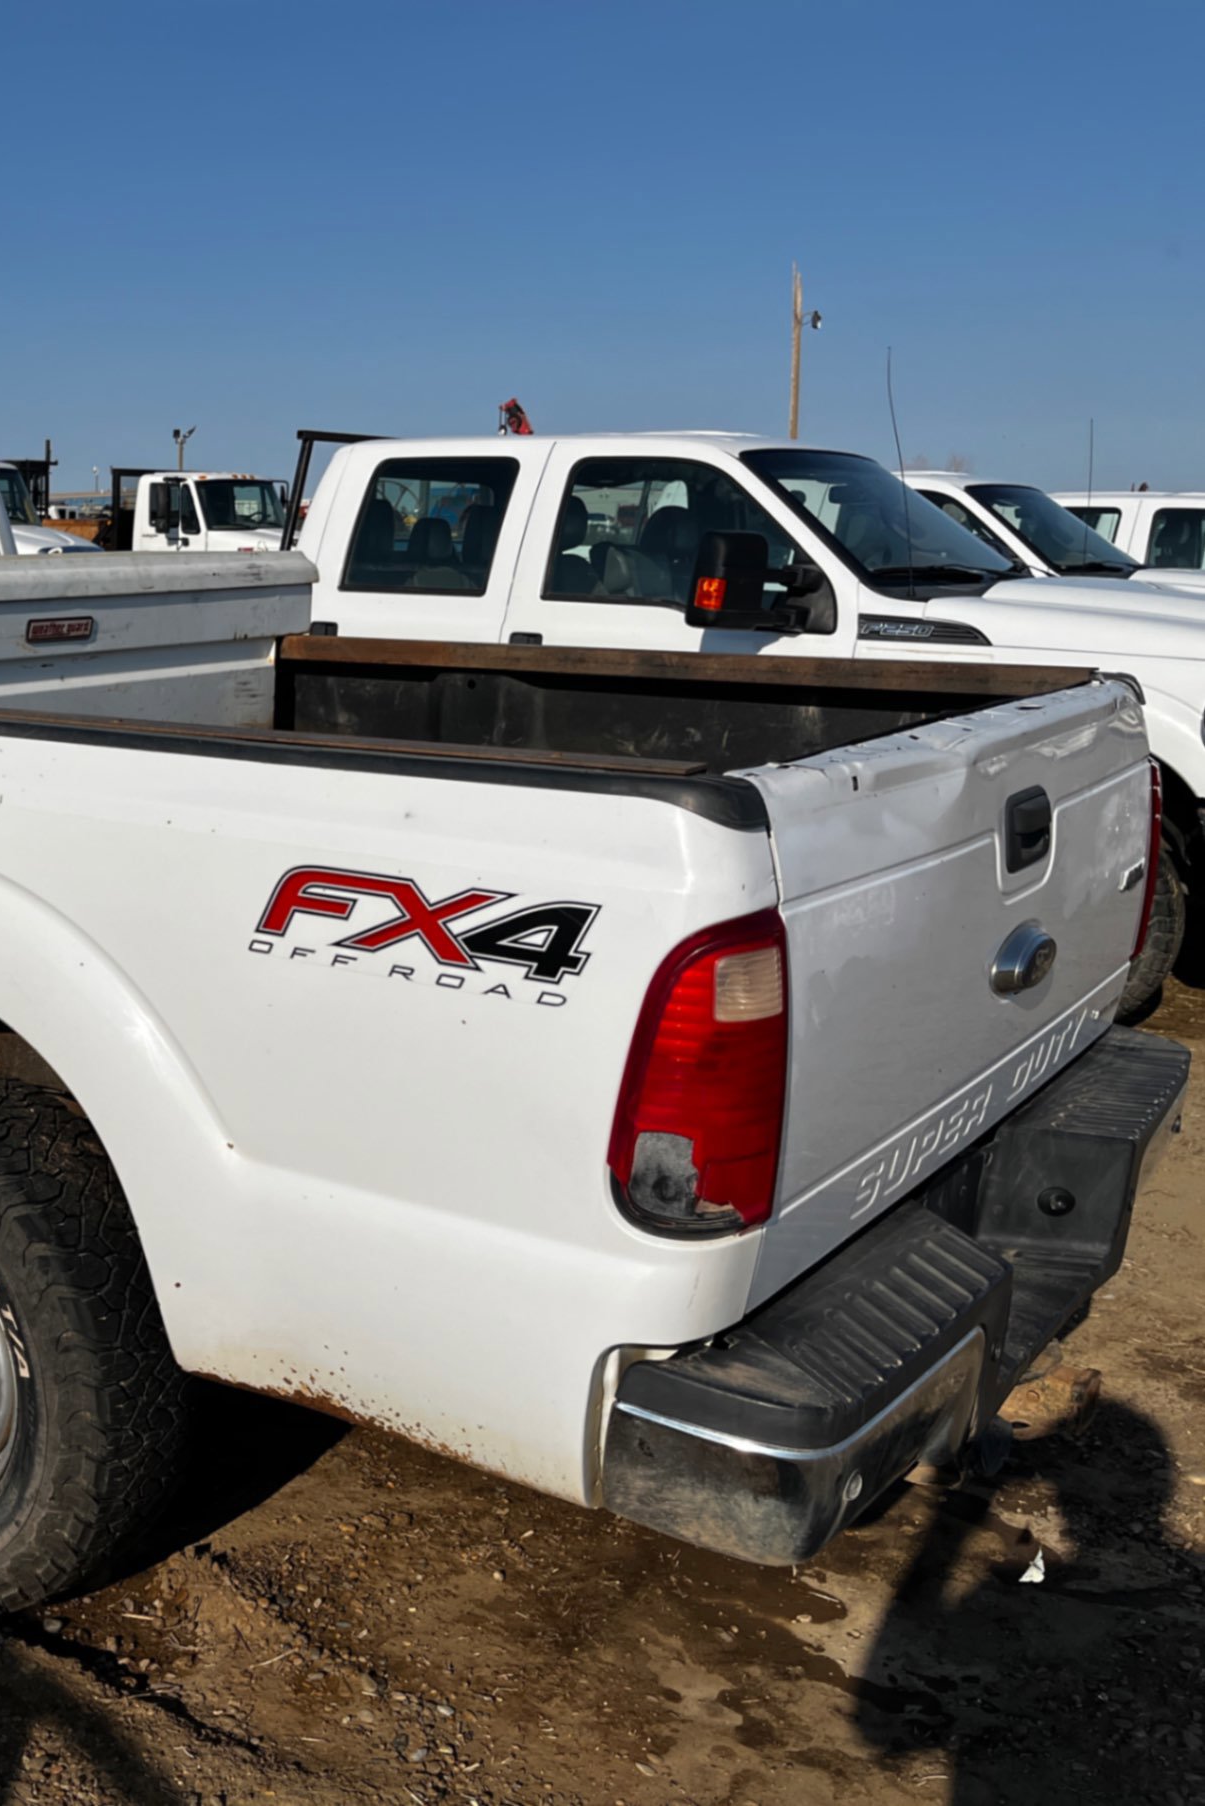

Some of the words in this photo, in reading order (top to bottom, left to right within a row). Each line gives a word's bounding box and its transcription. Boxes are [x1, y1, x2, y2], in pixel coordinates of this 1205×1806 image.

[248, 939, 359, 968] OFF
[387, 964, 568, 1007] ROAD
[254, 864, 603, 985] FX4
[850, 1083, 993, 1220] SUPER
[1006, 1007, 1088, 1103] DUTY
[0, 1303, 31, 1378] T/A
